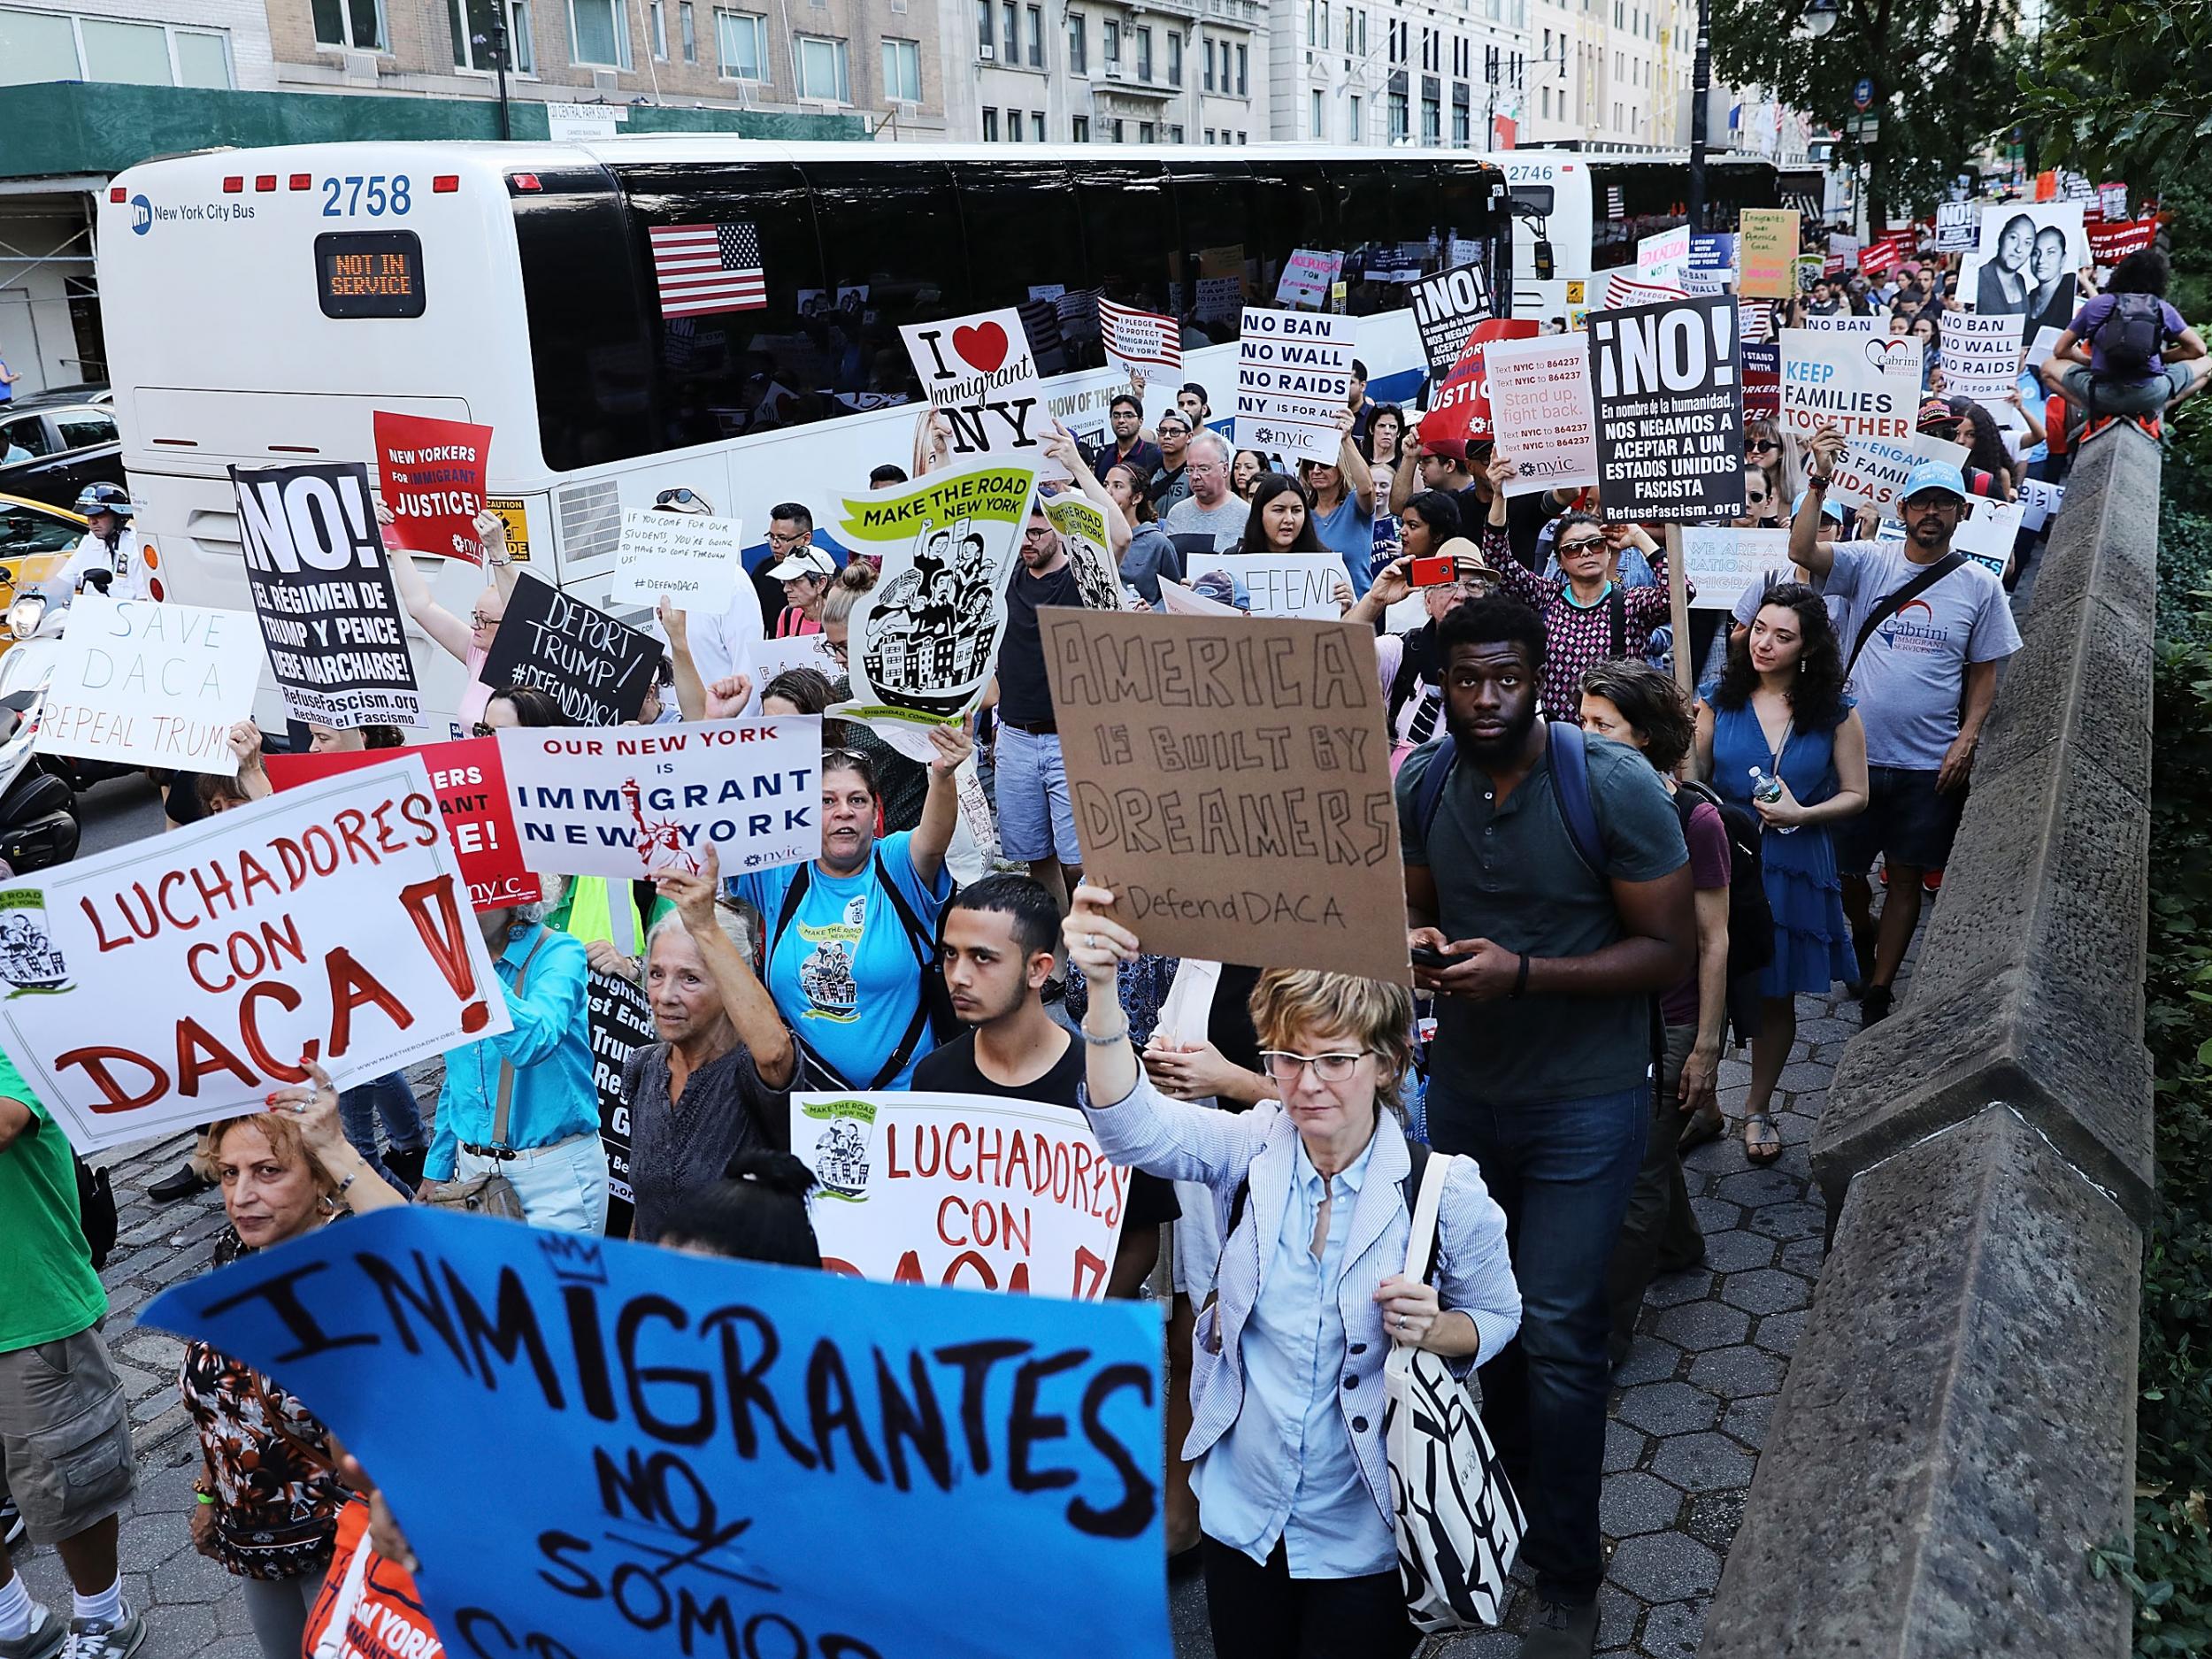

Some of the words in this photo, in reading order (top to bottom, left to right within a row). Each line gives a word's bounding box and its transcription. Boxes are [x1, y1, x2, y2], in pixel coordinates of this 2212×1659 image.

[558, 105, 582, 119] CENTRAL
[582, 105, 595, 119] PARK
[596, 106, 614, 119] SOUTH
[1509, 165, 1554, 180] 2746
[322, 174, 411, 217] 2758
[155, 206, 177, 220] New
[180, 205, 204, 219] York
[206, 204, 229, 221] City
[233, 204, 255, 219] Bus
[1939, 204, 1972, 227] NO!
[335, 254, 372, 274] NOT
[381, 254, 404, 274] IN
[1651, 264, 1669, 276] NOT
[331, 276, 411, 296] SERVICE
[1410, 266, 1489, 326] ¡NO!
[1690, 284, 1717, 293] WALL
[1125, 328, 1159, 337] PROTECT
[1243, 315, 1276, 332] NO
[1284, 319, 1331, 336] BAN
[1809, 319, 1830, 330] NO
[1837, 320, 1870, 331] BAN
[1941, 316, 1963, 329] NO
[1967, 318, 2004, 332] BAN
[1116, 334, 1159, 346] IMMIGRANT
[1118, 344, 1134, 353] NEW
[1596, 305, 1734, 398] ¡NO!
[1941, 336, 1960, 349] NO
[1965, 340, 2013, 352] WALL
[918, 330, 956, 380] I
[1241, 343, 1273, 359] NO
[1281, 347, 1342, 366] WALL
[1495, 365, 1511, 374] Text
[1513, 363, 1534, 373] NYIC
[1547, 357, 1579, 368] 864237
[1878, 355, 1918, 366] Cabrini
[929, 354, 1033, 409] Immigrant
[1240, 370, 1271, 387] NO
[1279, 374, 1346, 395] RAIDS
[1497, 379, 1513, 388] Text
[1515, 376, 1535, 386] NYIC
[1548, 372, 1580, 382] 864237
[1786, 361, 1834, 384] KEEP
[1238, 396, 1267, 412] NY
[1292, 406, 1316, 415] FOR
[1601, 403, 1614, 419] En
[1616, 400, 1649, 418] nombre
[1649, 401, 1658, 417] de
[1660, 400, 1670, 414] la
[1671, 392, 1735, 412] humanidad,
[1785, 385, 1893, 413] FAMILIES
[939, 397, 1037, 453] NY
[1502, 408, 1537, 425] fight
[1542, 403, 1583, 419] back.
[1785, 408, 1909, 439] TOGETHER
[1605, 422, 1637, 441] NOS
[1640, 414, 1715, 437] NEGAMOS
[1720, 412, 1734, 432] A
[389, 448, 415, 465] NEW
[418, 446, 476, 464] YORKERS
[1614, 440, 1678, 459] ACEPTAR
[1682, 438, 1695, 455] A
[1700, 434, 1725, 453] UN
[1537, 456, 1575, 476] nyic
[1606, 460, 1668, 480] ESTADOS
[1671, 455, 1738, 476] UNIDOS
[392, 472, 408, 483] FOR
[411, 470, 475, 486] IMMIGRANT
[1634, 479, 1704, 499] FASCISTA
[395, 491, 481, 518] JUSTICE!
[863, 499, 927, 528] MAKE
[930, 480, 975, 508] THE
[976, 476, 1027, 495] ROAD
[944, 499, 981, 520] NEW
[986, 497, 1021, 515] YORK
[1607, 502, 1741, 520] RefuseFascism.org
[627, 513, 637, 523] IF
[642, 514, 657, 524] YOU
[657, 518, 681, 526] COME
[687, 519, 705, 528] FOR
[709, 522, 728, 532] OUR
[625, 528, 668, 543] STUDENTS,
[675, 534, 703, 546] YOU'RE
[621, 555, 637, 565] US!
[634, 545, 654, 554] HAVE
[670, 548, 689, 557] COME
[693, 549, 726, 560] THROUGH
[273, 580, 358, 613] RÉGIMEN
[361, 582, 388, 610] DE
[109, 603, 225, 649] SAVE
[261, 615, 308, 648] TRUMP
[311, 618, 328, 648] Y
[337, 617, 401, 646] PENCE
[543, 592, 639, 659] DEPORT
[1884, 618, 1948, 641] Cabrini
[1894, 635, 1946, 649] IMMIGRANT
[526, 619, 643, 694] TRUMP!
[1051, 620, 1368, 709] AMERICA
[81, 648, 221, 701] DACA
[272, 652, 304, 680] DEBE
[302, 652, 411, 685] MARCHARSE!
[282, 687, 419, 713] RefuseFascism.org
[293, 707, 333, 726] Rechazar
[335, 712, 350, 726] el
[354, 711, 415, 726] Fascismo
[41, 703, 134, 747] REPEAL
[152, 717, 234, 762] TRUM
[543, 740, 603, 756] OUR
[617, 734, 687, 756] NEW
[700, 726, 779, 748] YORK
[1094, 724, 1133, 766] IS
[1149, 726, 1292, 772] BUILT
[1309, 724, 1370, 774] BY
[657, 763, 674, 774] IS
[518, 769, 812, 811] IMMIGRANT
[524, 822, 636, 848] NEW
[679, 806, 812, 847] YORK
[1076, 780, 1392, 866] DREAMERS
[80, 792, 439, 953] LUCHADORES
[187, 912, 308, 995] CON
[357, 1031, 456, 1071] WWW.MAKETHEROADNY.ORG
[851, 1102, 875, 1115] ROAD
[936, 1195, 1032, 1256] CON
[203, 1250, 1158, 1540] INMIGRANTES
